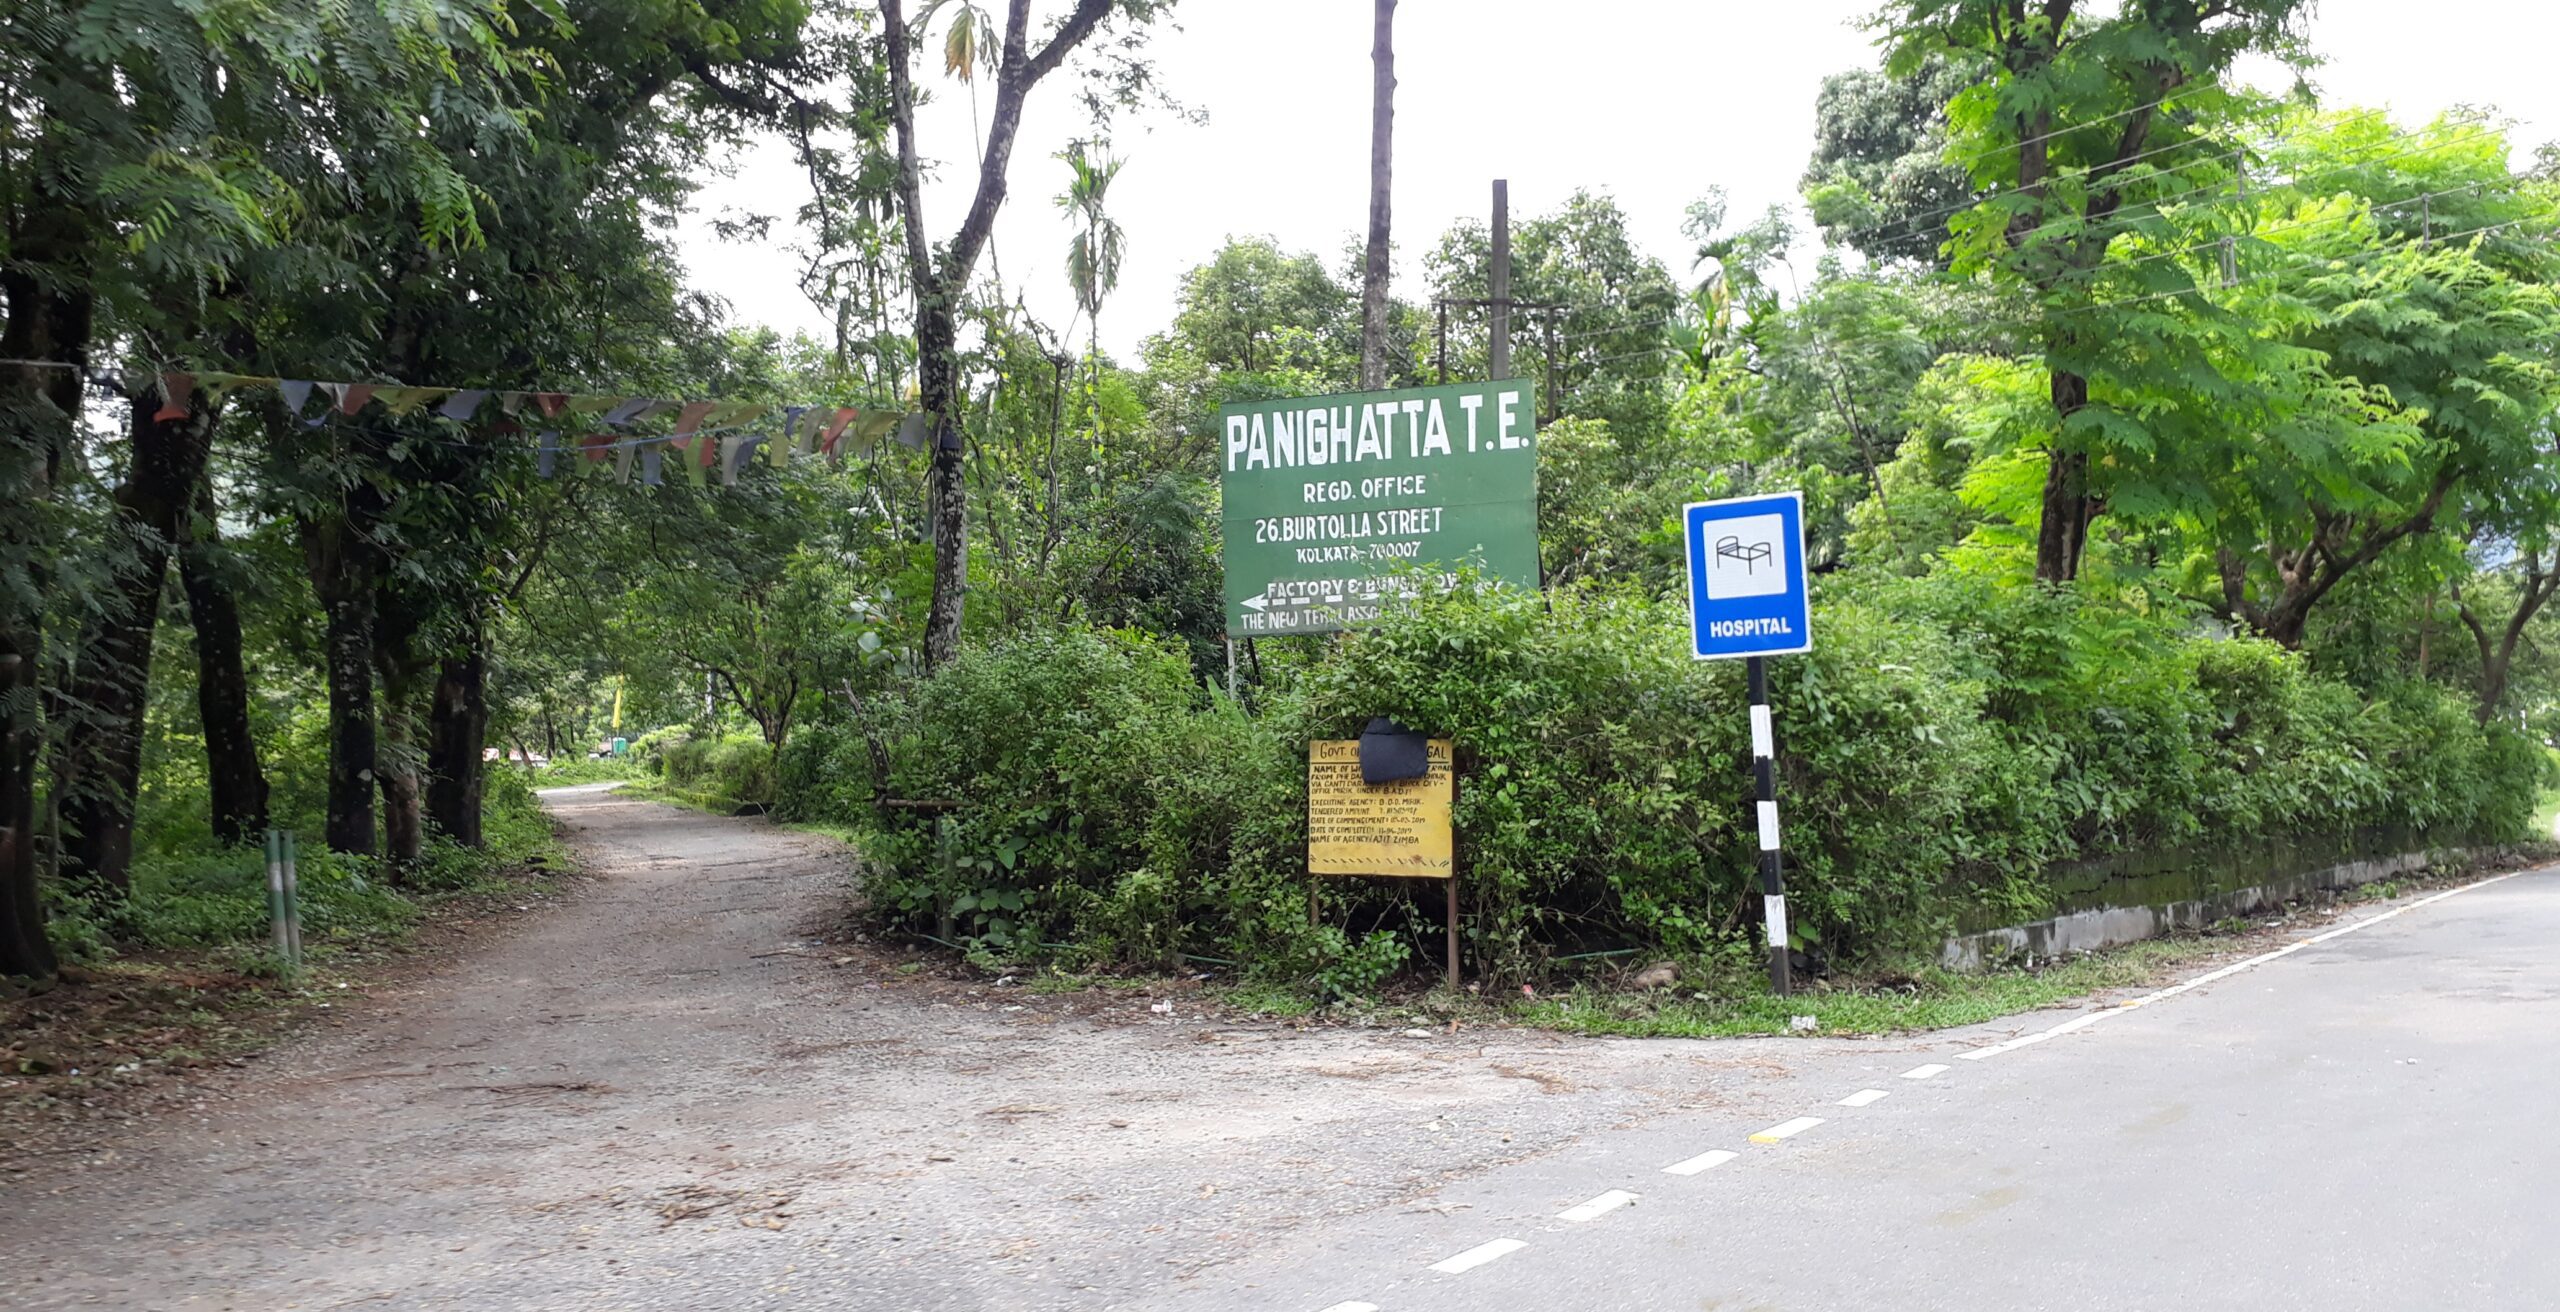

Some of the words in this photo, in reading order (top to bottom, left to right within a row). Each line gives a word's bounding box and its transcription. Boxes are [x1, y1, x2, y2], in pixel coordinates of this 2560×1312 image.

[1226, 398, 1451, 471] PANIGHATTA
[1459, 391, 1530, 453] T.E.
[1303, 481, 1356, 503] REGD.
[1361, 475, 1427, 498] OFFICE
[1377, 506, 1443, 536] STREET
[1267, 579, 1343, 599] FACTORY
[1347, 579, 1363, 594] &
[1241, 612, 1265, 630] THE
[1268, 610, 1298, 630] NEW
[1710, 617, 1792, 637] HOSPITAL
[1314, 765, 1337, 773] NAME
[1340, 765, 1350, 773] OF
[1310, 816, 1325, 824] DATE
[1327, 816, 1335, 824] OF
[1310, 826, 1326, 834] DATE
[1310, 835, 1330, 843] NAME
[1333, 835, 1342, 843] OF
[1393, 836, 1420, 844] ZIMBA
